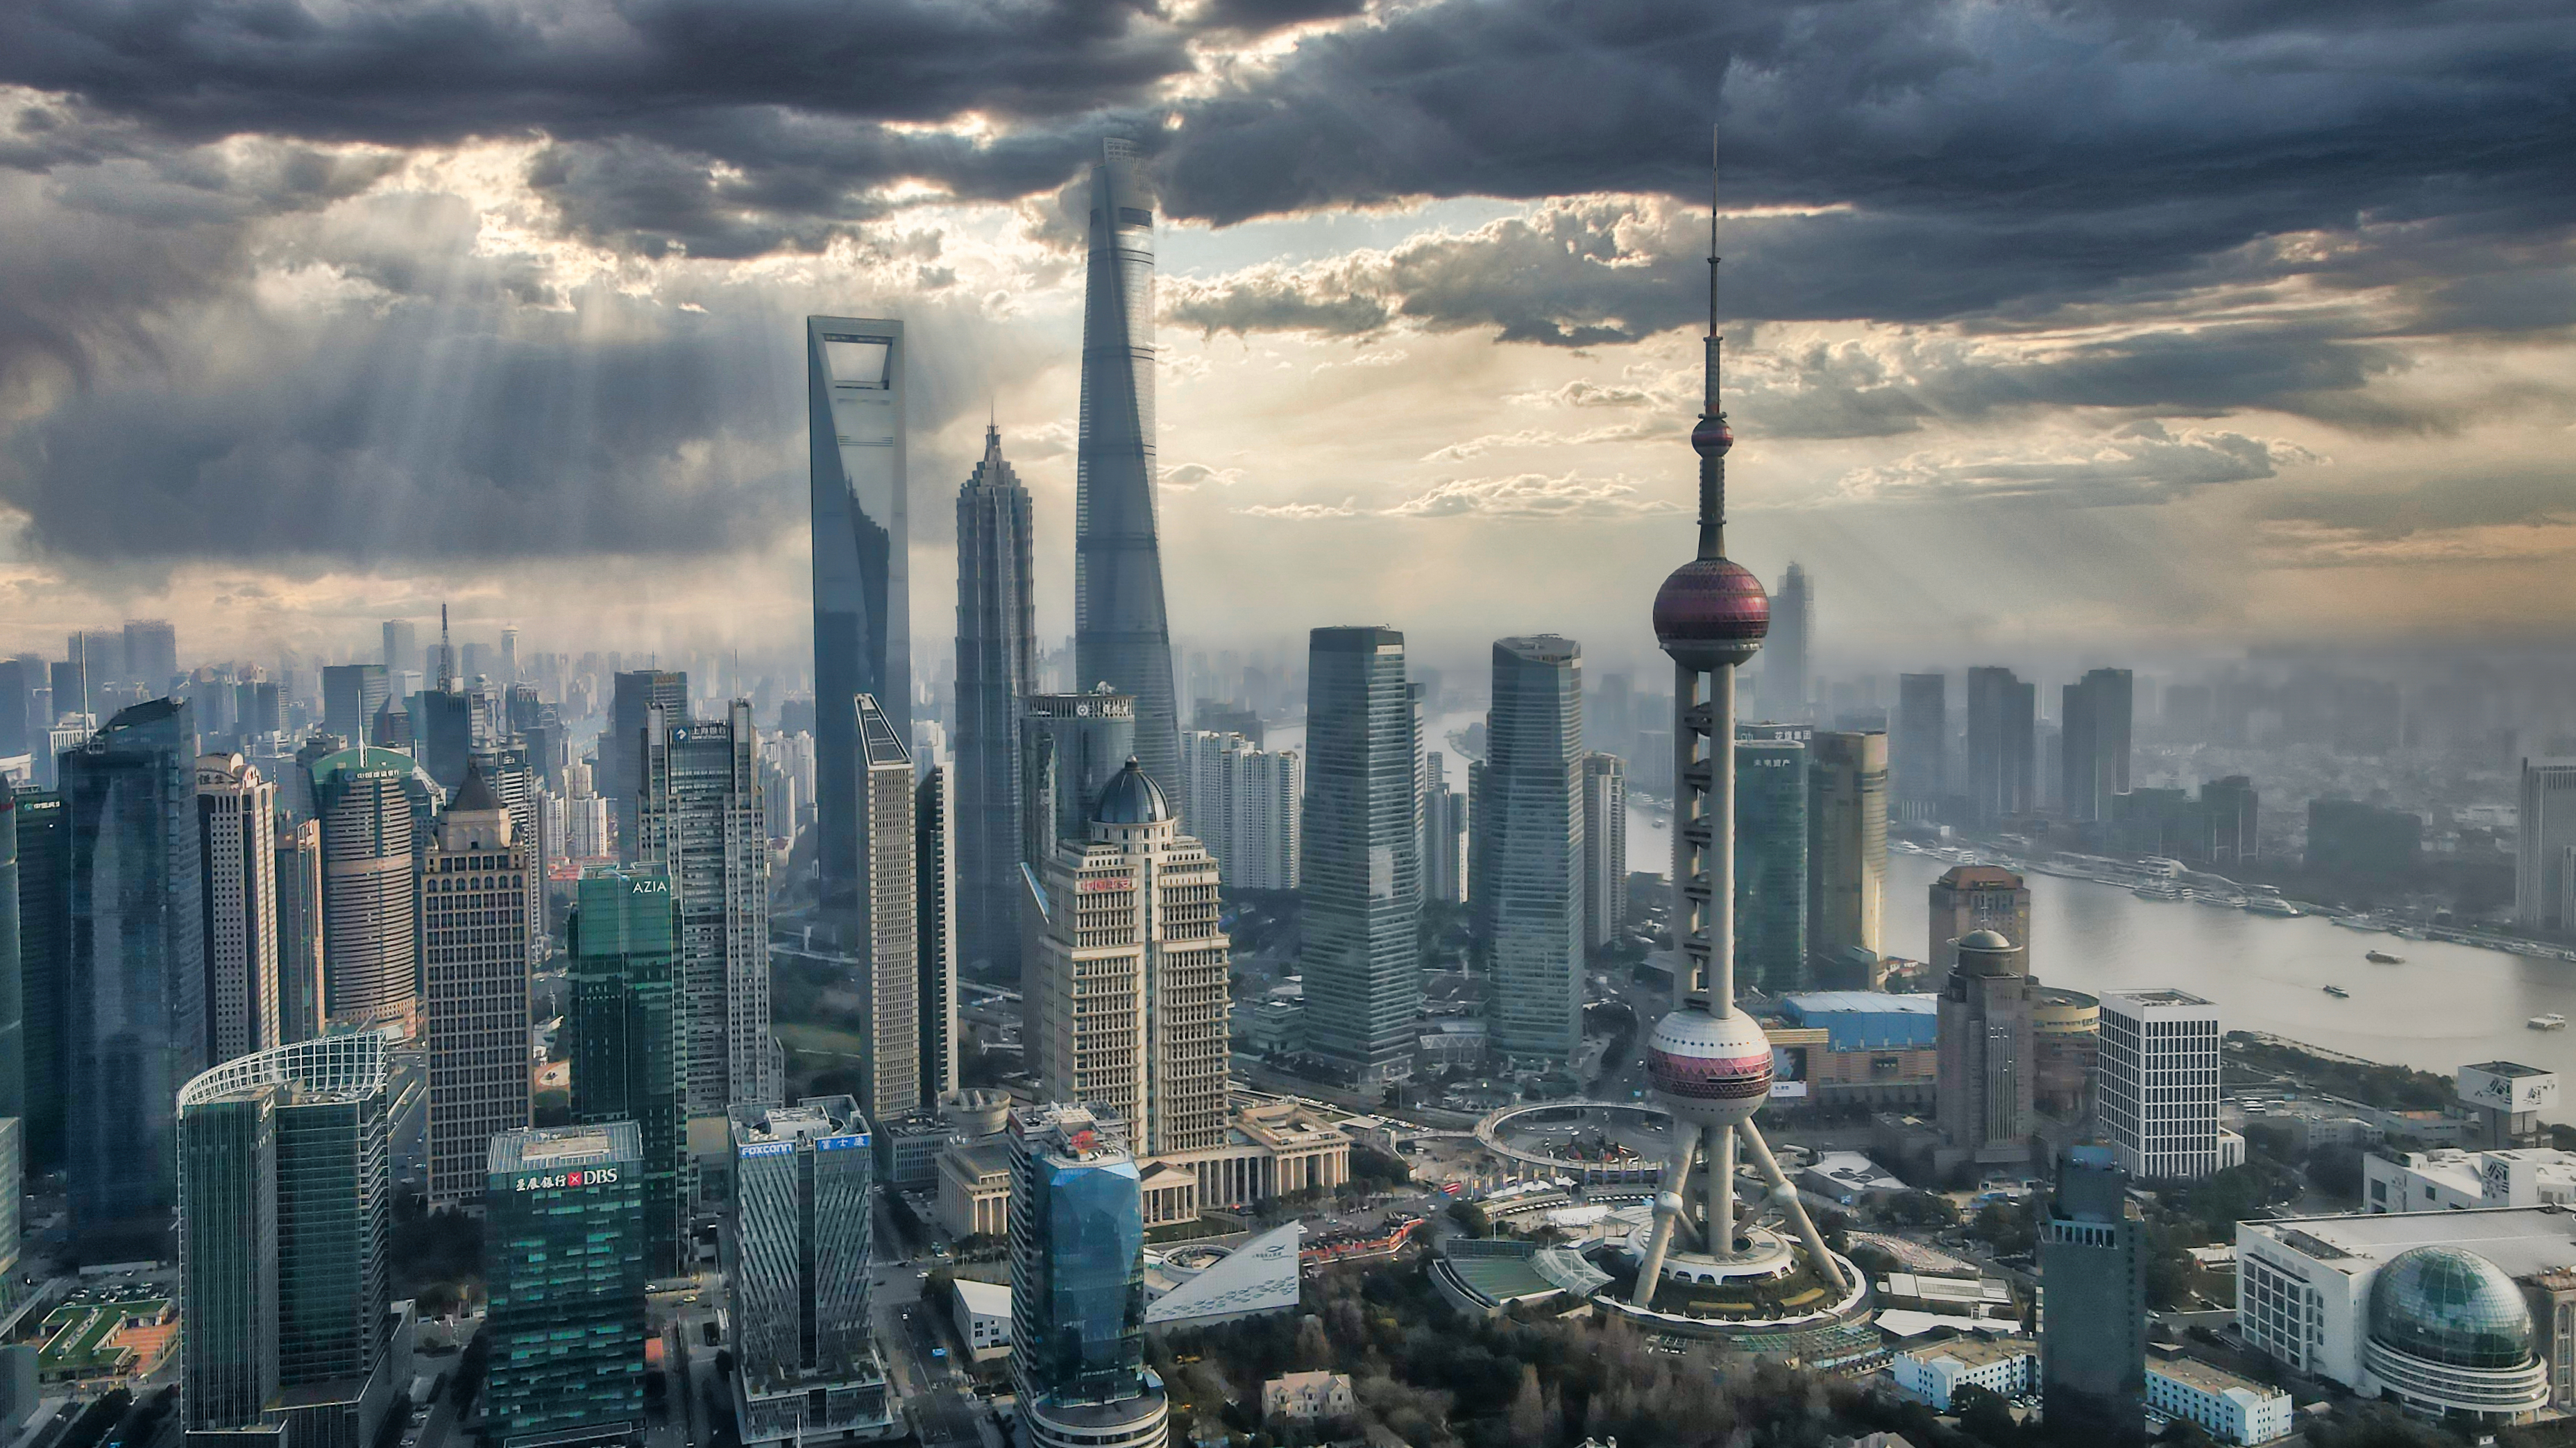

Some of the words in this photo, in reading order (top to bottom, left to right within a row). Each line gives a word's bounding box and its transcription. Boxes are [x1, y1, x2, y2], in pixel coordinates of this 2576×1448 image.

[1774, 730, 1812, 740] 花旗集团
[632, 880, 667, 894] AZIA
[820, 1136, 865, 1150] 富士康
[516, 1175, 567, 1192] 星展银行
[584, 1168, 618, 1185] DBS
